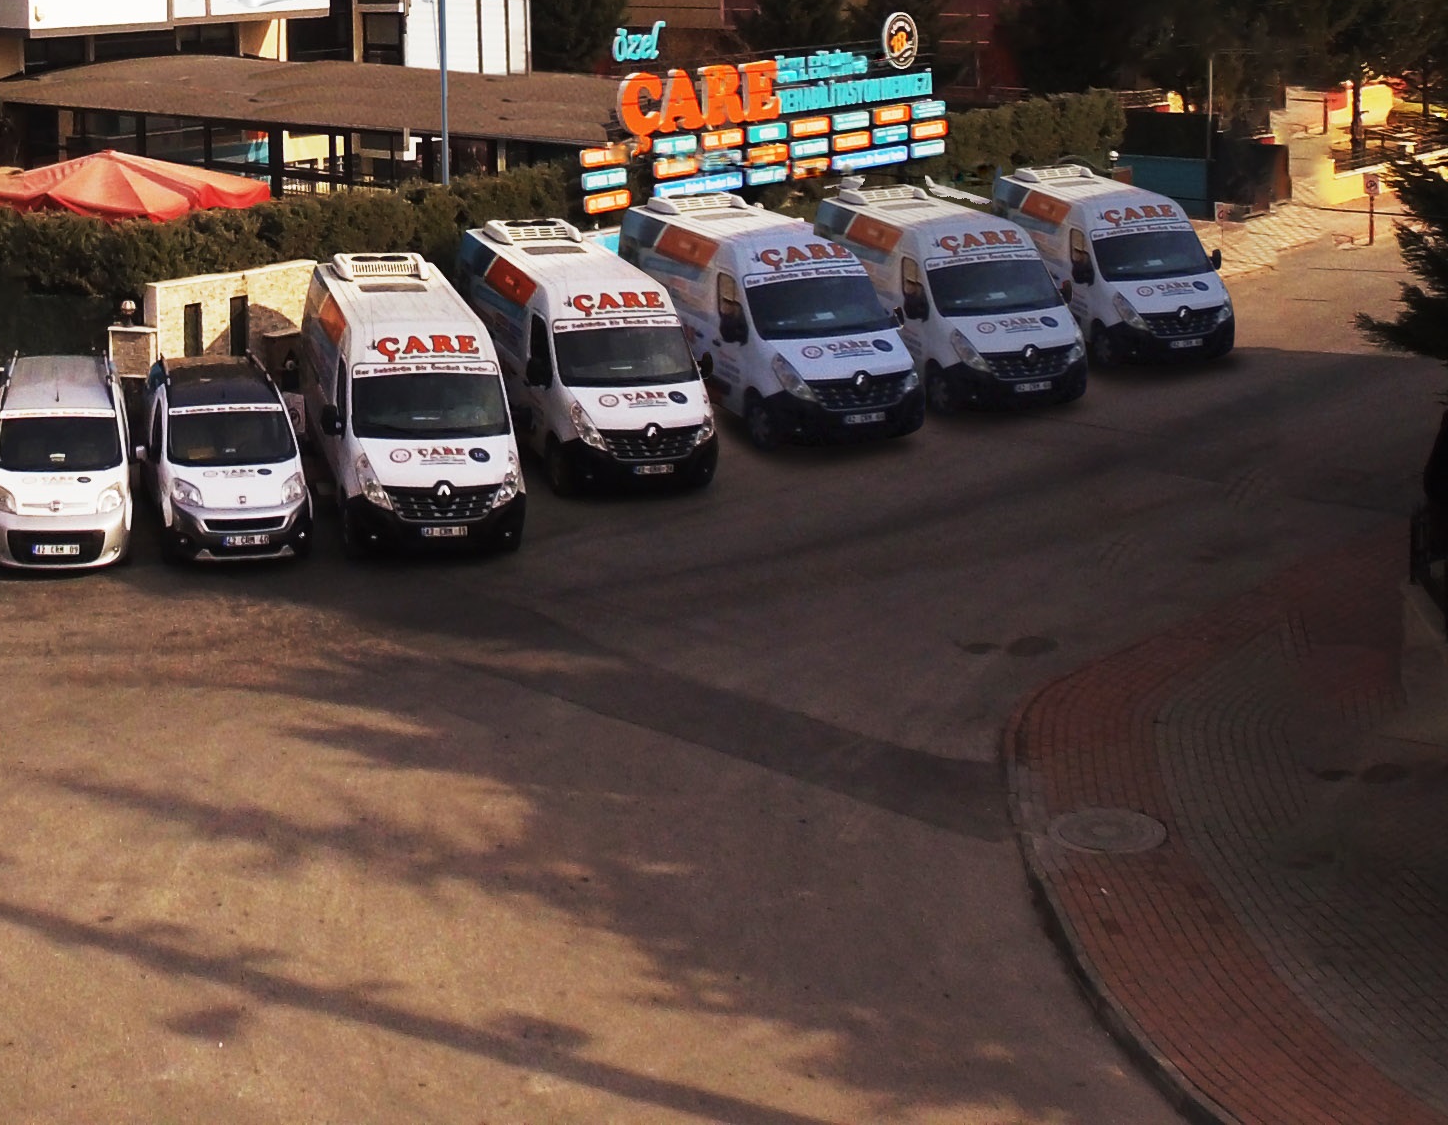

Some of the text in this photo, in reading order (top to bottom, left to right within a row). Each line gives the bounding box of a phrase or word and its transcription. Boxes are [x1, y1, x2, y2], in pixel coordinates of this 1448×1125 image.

[616, 60, 780, 156] ÇARE
[1104, 204, 1177, 226] ÇARE
[940, 230, 1022, 255] ÇARE
[760, 243, 853, 271] ÇARE
[573, 291, 665, 317] ÇARE
[376, 335, 480, 362] ÇARE
